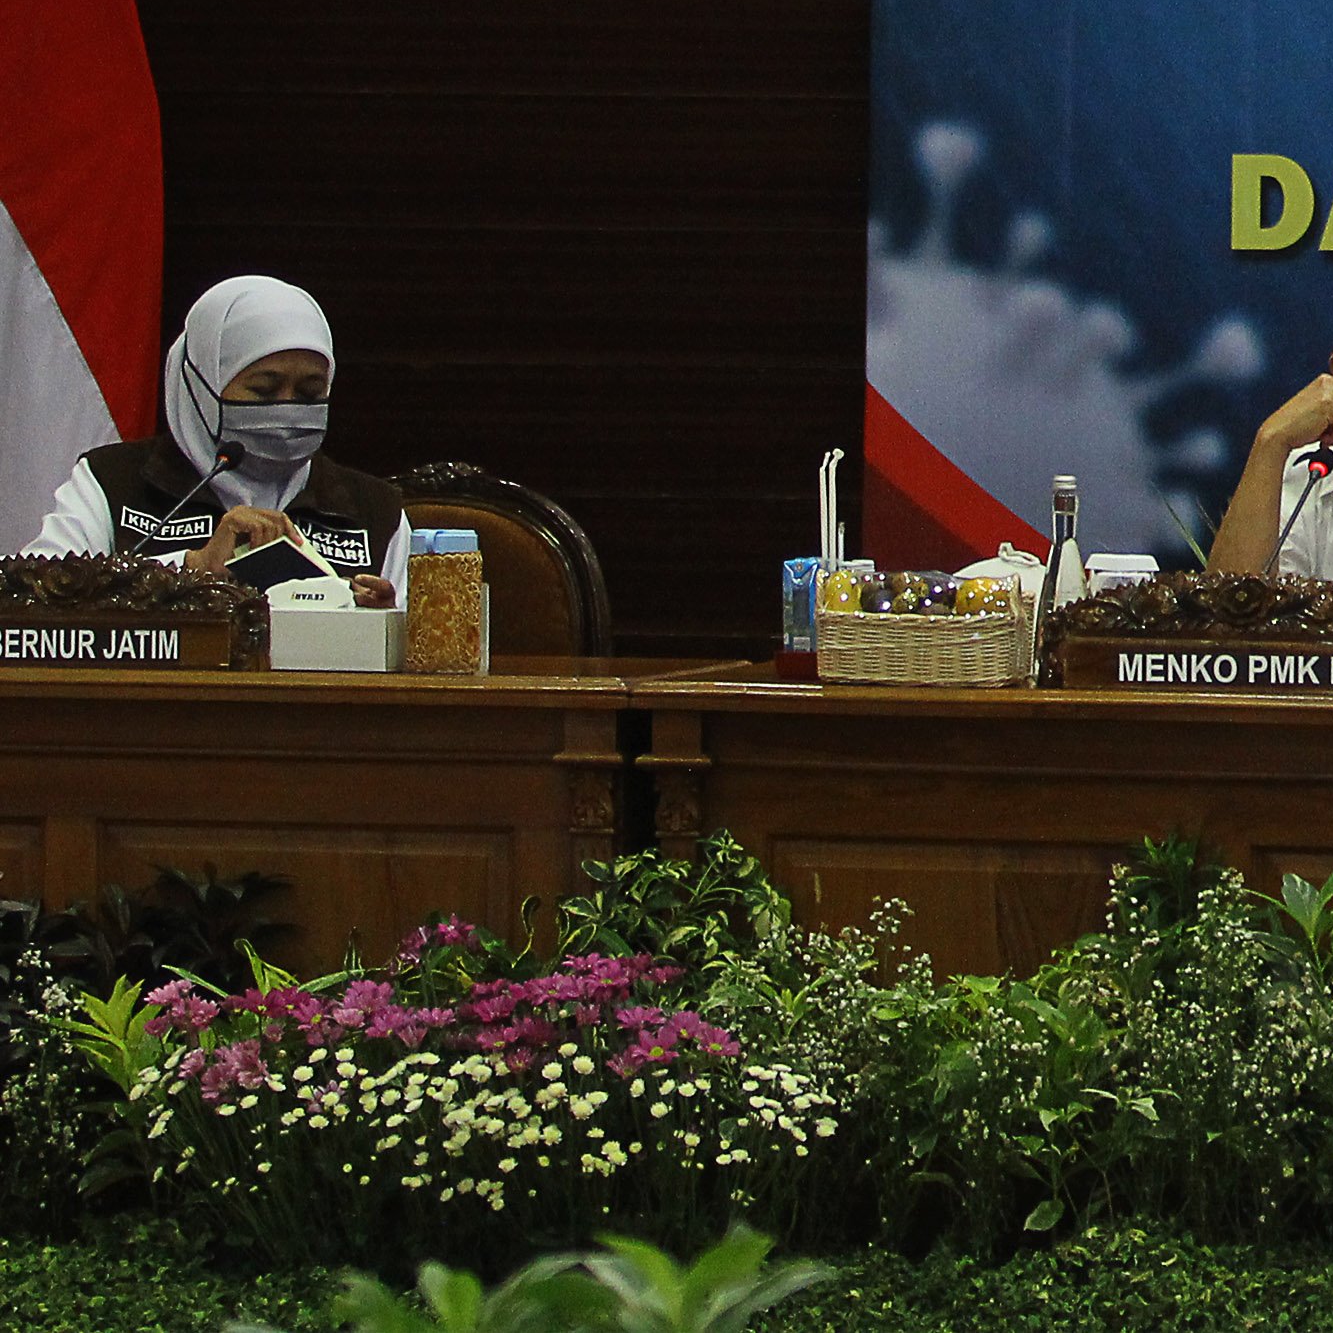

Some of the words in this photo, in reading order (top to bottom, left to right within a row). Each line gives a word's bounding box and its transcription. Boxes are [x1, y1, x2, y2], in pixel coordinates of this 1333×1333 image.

[0, 629, 96, 659] ERNUR
[103, 629, 178, 659] JATIM
[1119, 653, 1237, 683] MENKO
[1249, 655, 1319, 684] PMK
